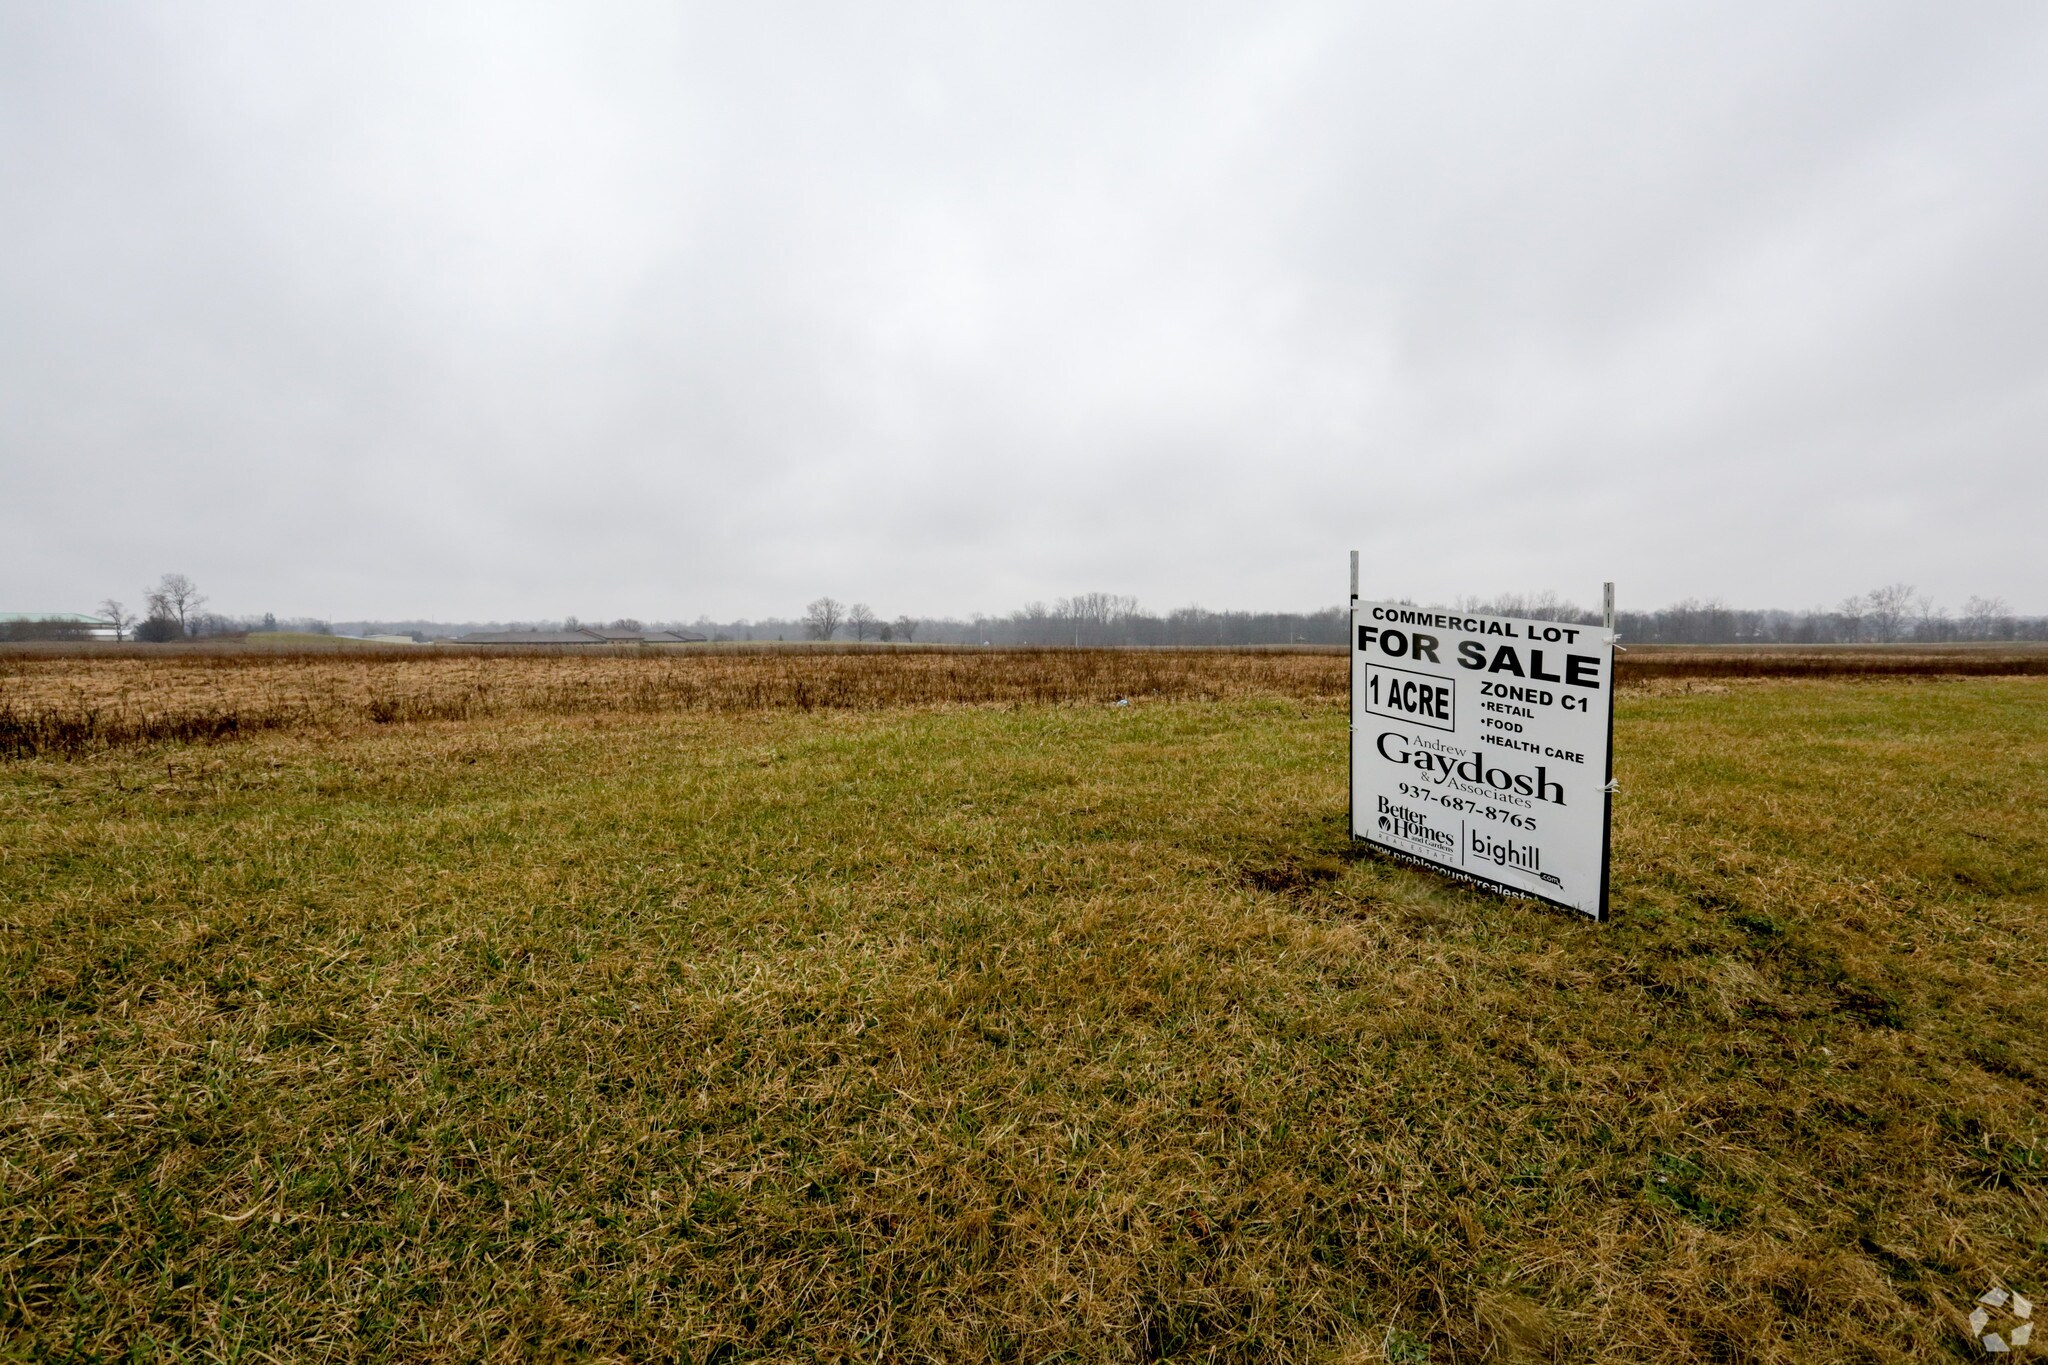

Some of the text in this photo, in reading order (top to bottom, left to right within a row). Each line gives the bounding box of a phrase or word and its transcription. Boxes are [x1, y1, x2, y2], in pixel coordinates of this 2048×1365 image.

[1372, 607, 1580, 644] COMMERCIAL LOT
[1358, 625, 1601, 689] FOR SALE
[1370, 674, 1449, 721] 1 ACRE
[1480, 681, 1588, 713] ZONED C1
[1413, 735, 1467, 757] Andrew
[1544, 747, 1585, 764] CARE
[1376, 732, 1567, 806] Gaydosh
[1399, 782, 1537, 831] 937-687-8765
[1420, 771, 1532, 809] & Associates
[1377, 794, 1427, 825] Better
[1379, 833, 1453, 863] REAL ESTATE
[1394, 818, 1454, 847] Homes
[1425, 839, 1454, 853] Gardens
[1472, 829, 1539, 871] bighill
